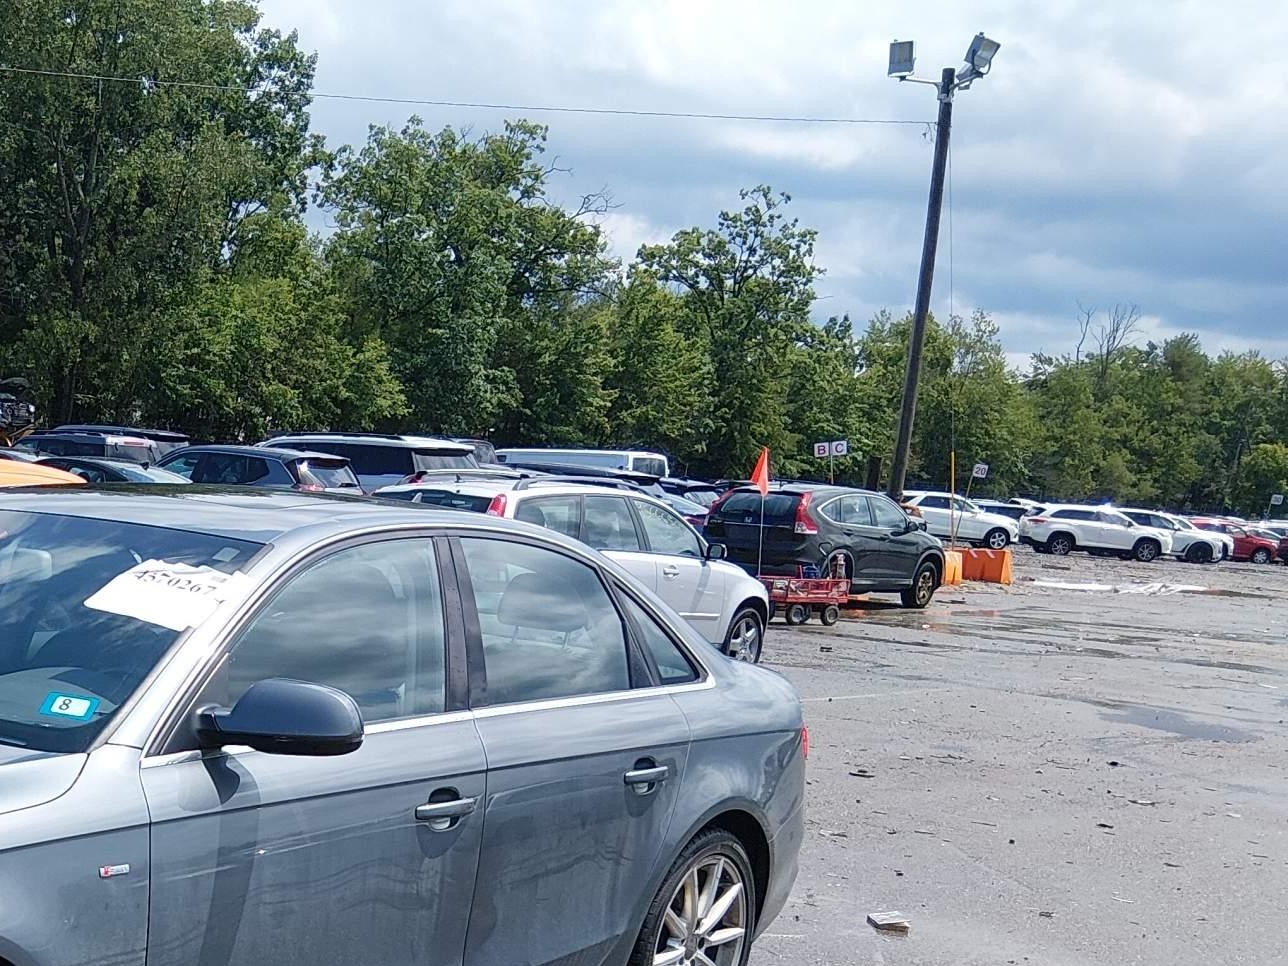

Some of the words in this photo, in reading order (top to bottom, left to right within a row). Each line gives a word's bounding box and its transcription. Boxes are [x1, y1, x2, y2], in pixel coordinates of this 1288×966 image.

[817, 445, 826, 455] B
[835, 443, 844, 453] C
[975, 466, 987, 476] 20
[58, 698, 72, 711] 8
